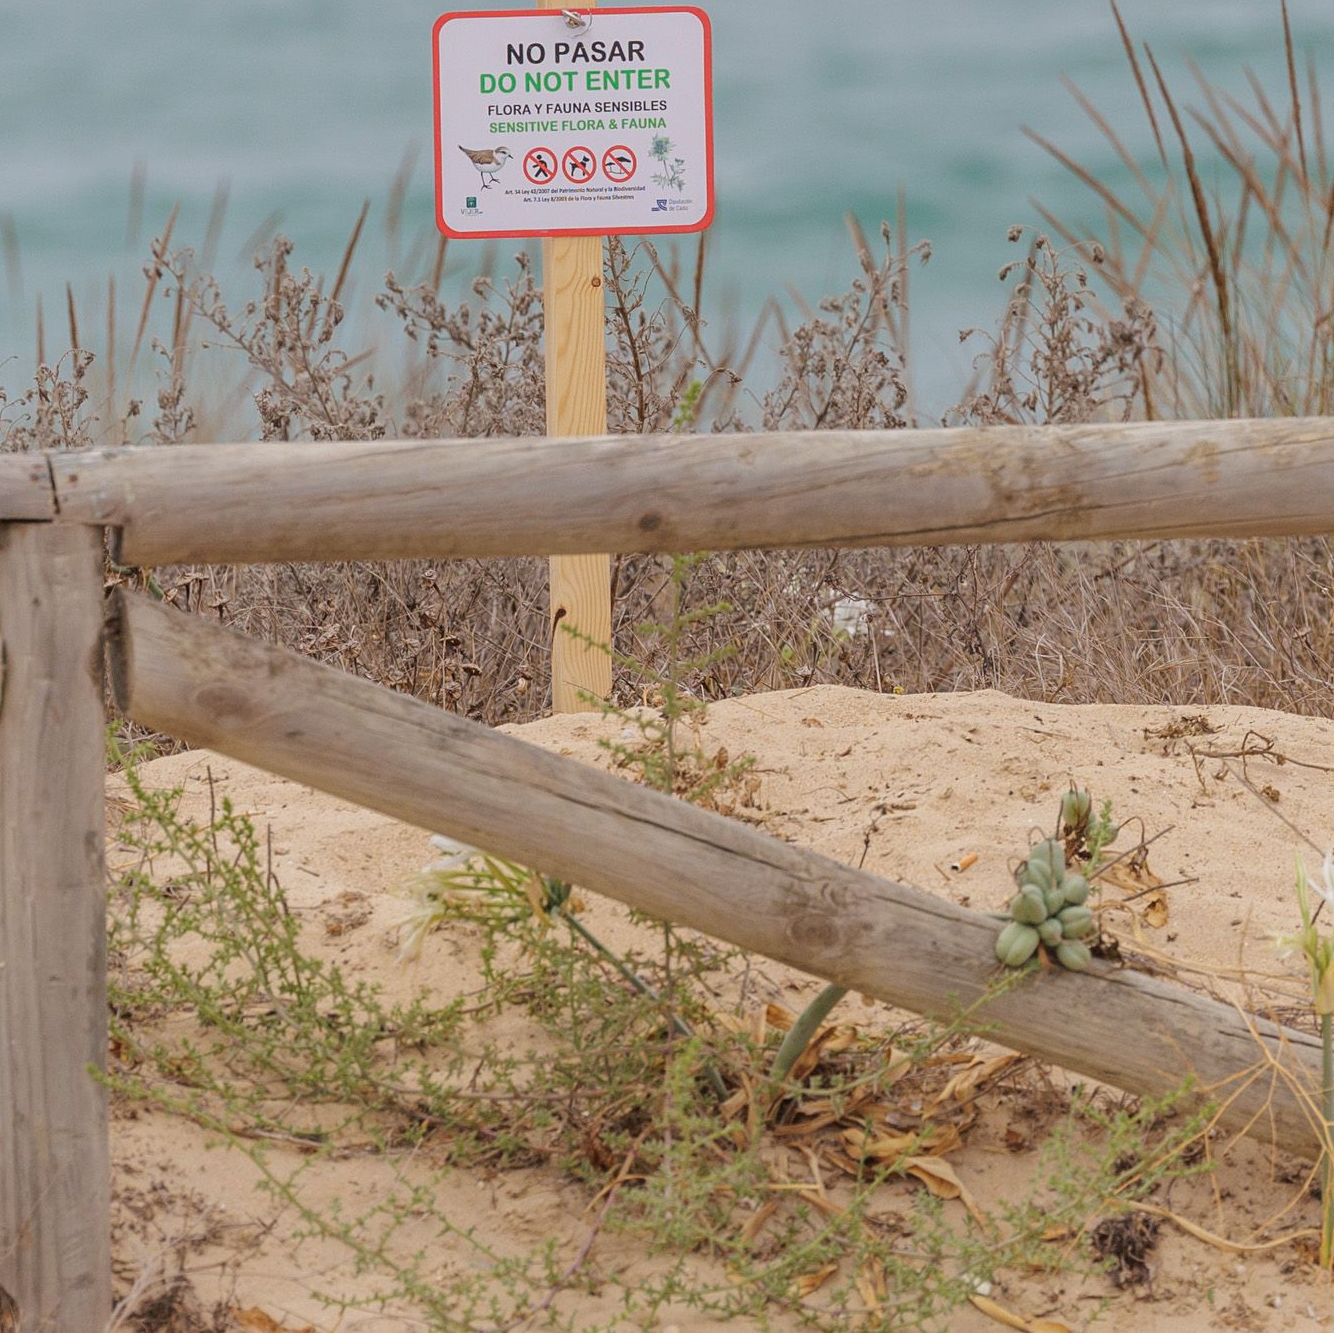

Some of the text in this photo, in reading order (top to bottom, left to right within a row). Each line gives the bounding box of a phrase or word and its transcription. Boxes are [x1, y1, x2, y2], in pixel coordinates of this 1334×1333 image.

[507, 40, 645, 65] NO PASAR
[480, 69, 671, 94] DO NOT ENTER
[488, 100, 667, 116] FLORA Y FAUNA SENSIBLES
[489, 117, 667, 133] SENSITIVE FLORA & FAUNA
